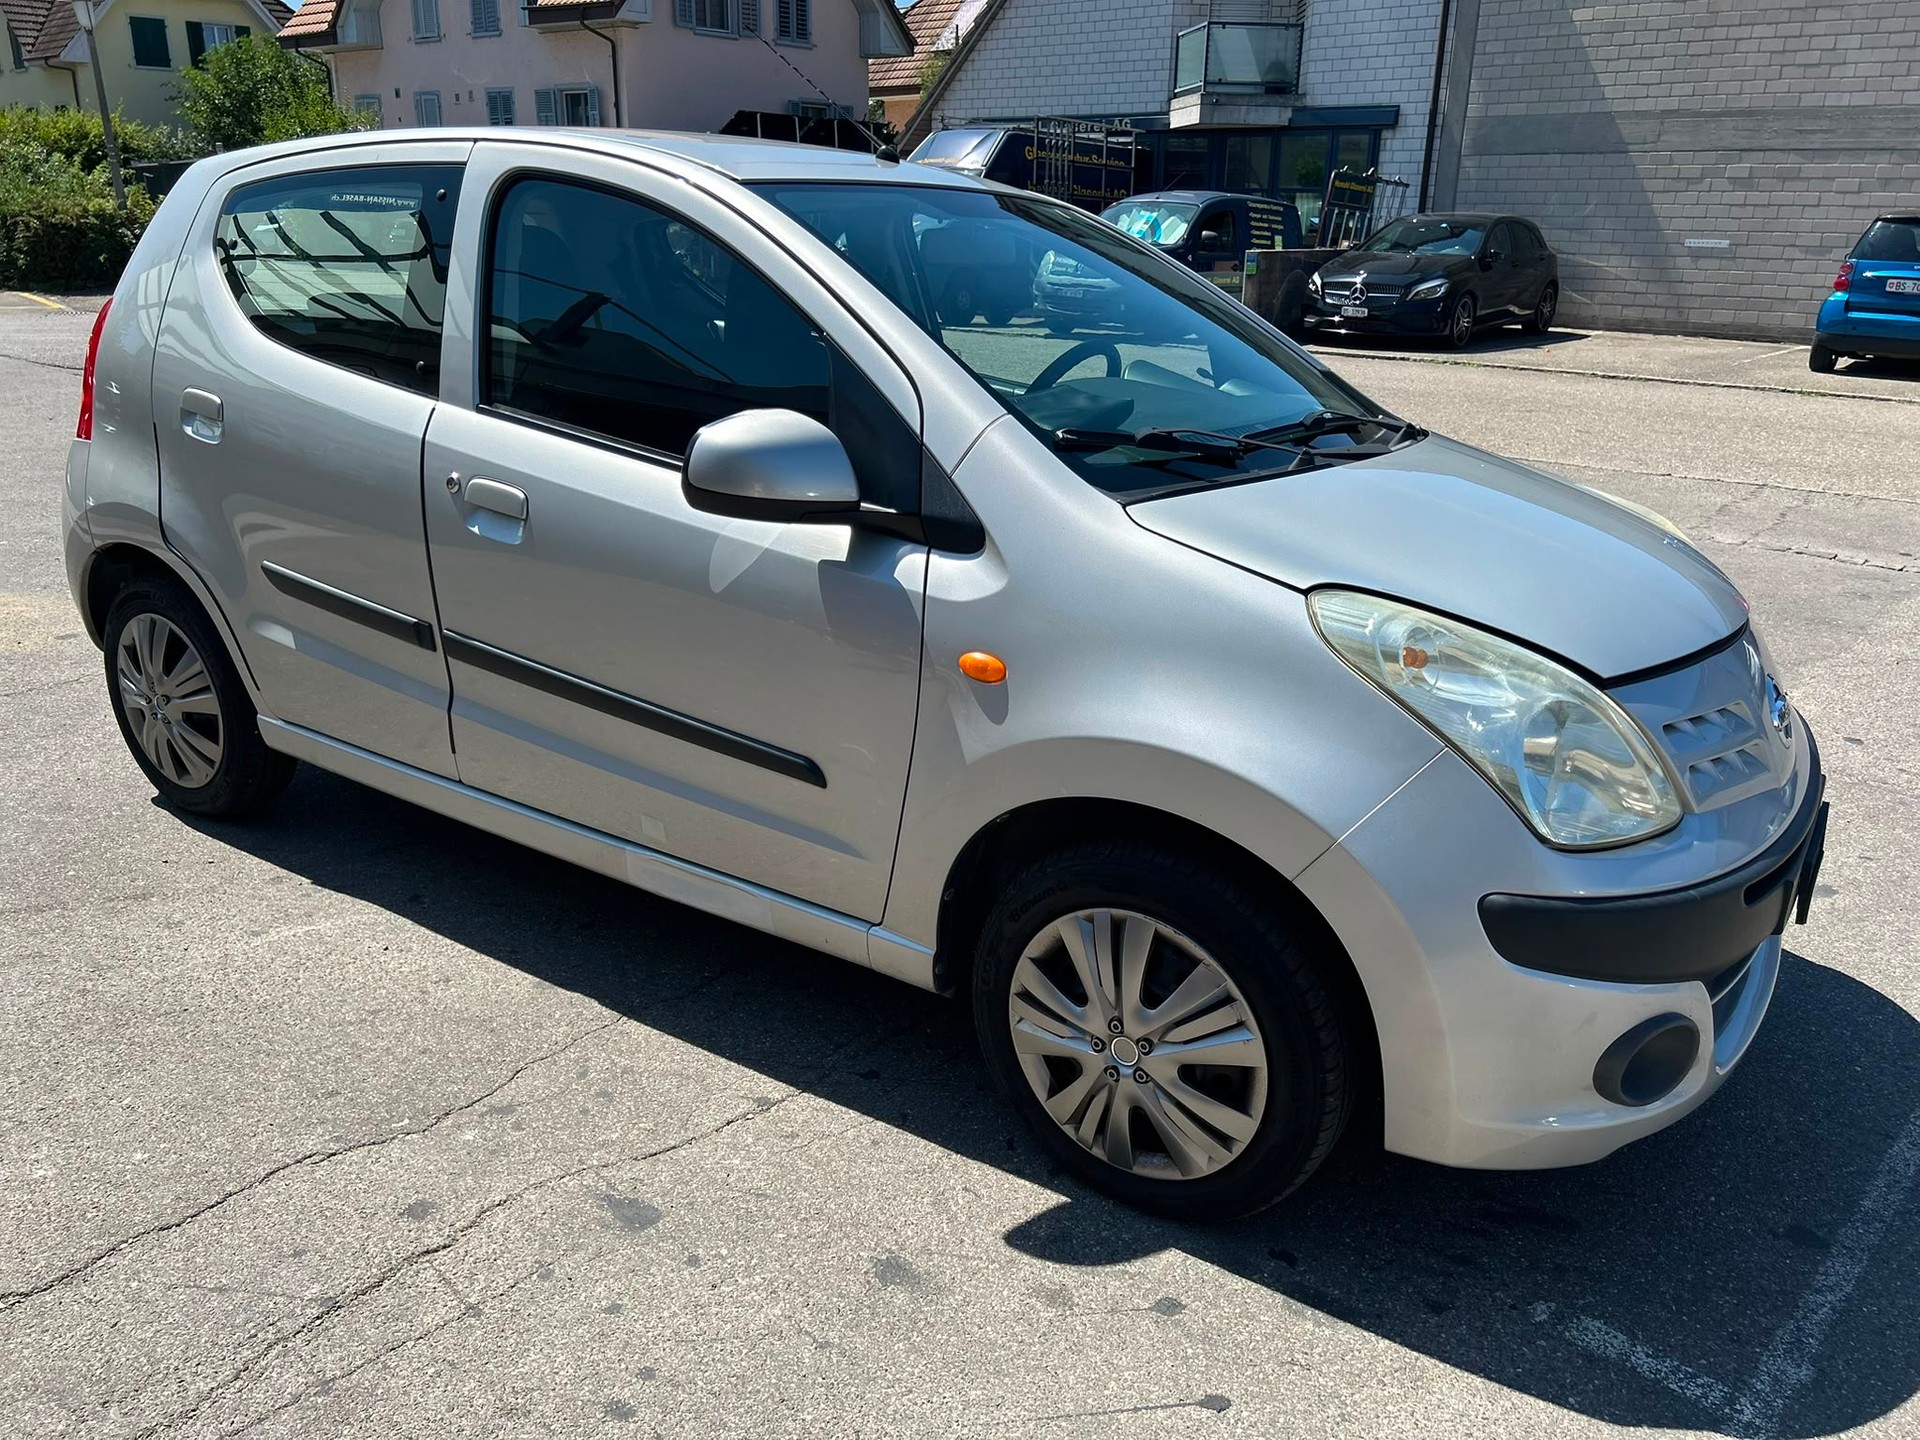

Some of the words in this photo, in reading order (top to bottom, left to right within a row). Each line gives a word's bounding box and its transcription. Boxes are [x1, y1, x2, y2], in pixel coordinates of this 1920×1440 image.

[1113, 119, 1132, 131] AG
[1073, 184, 1111, 197] Glaseri
[1895, 281, 1906, 291] BS
